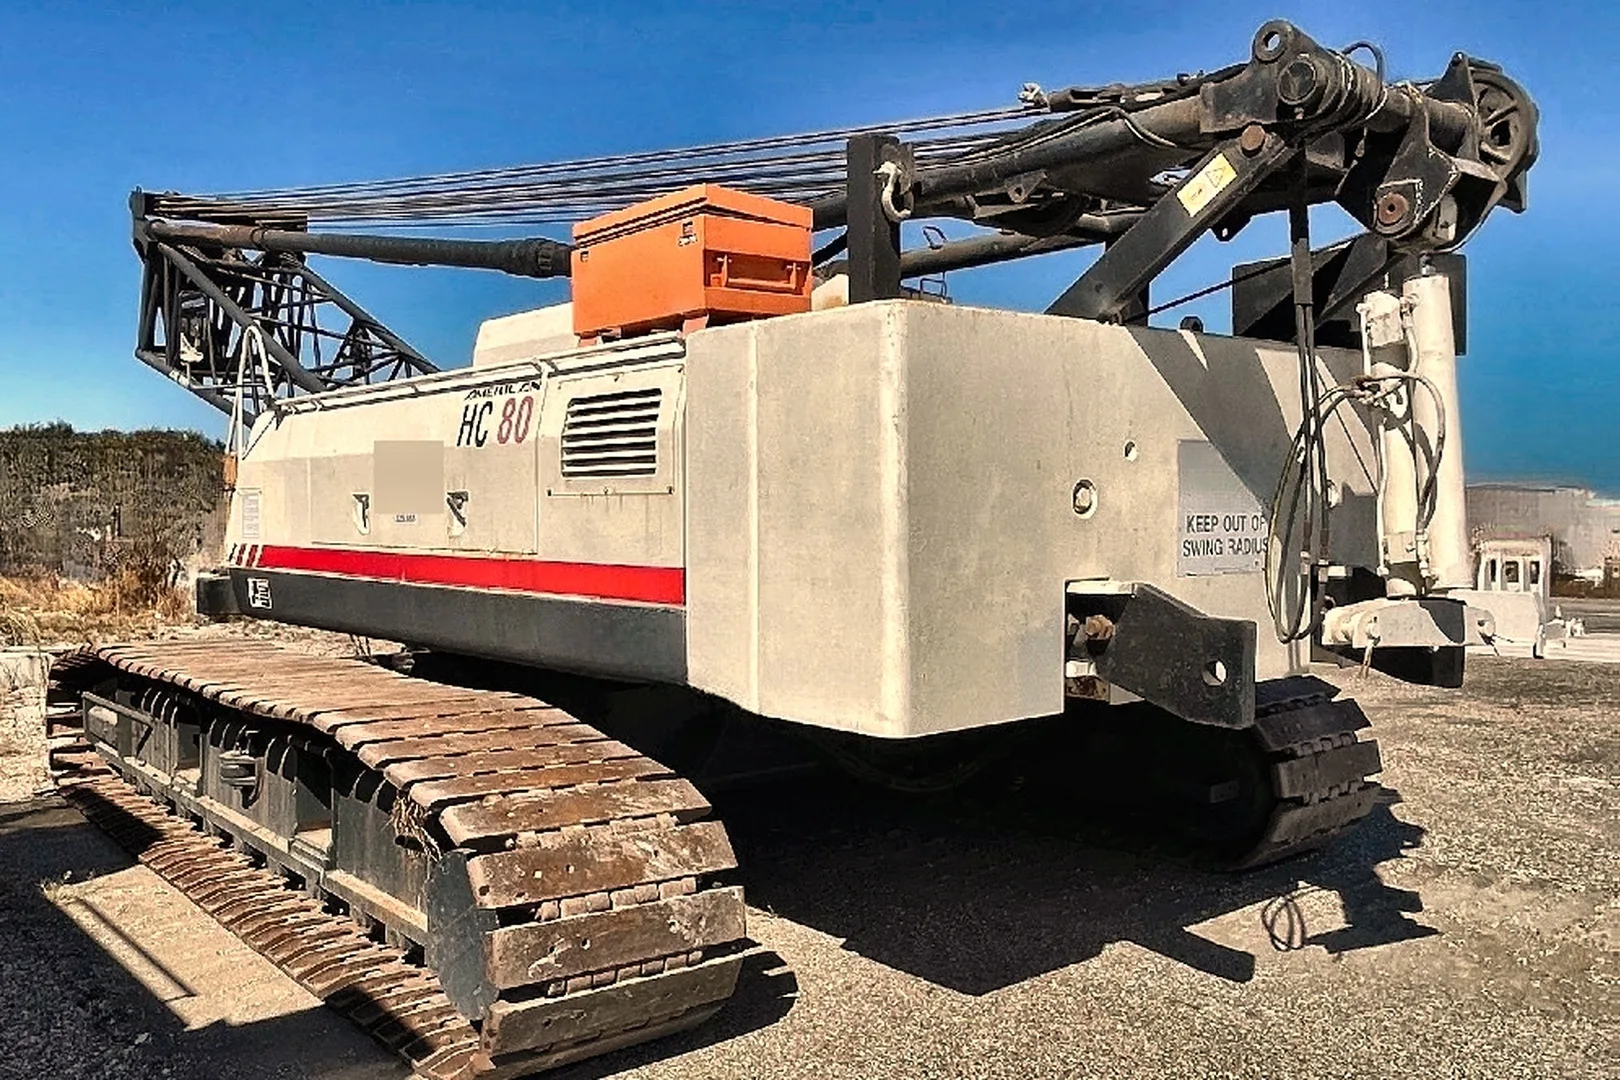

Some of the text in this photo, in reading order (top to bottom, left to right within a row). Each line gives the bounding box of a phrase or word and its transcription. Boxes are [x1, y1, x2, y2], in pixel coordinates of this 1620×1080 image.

[456, 396, 534, 448] HC 80
[1186, 514, 1219, 533] KEEP
[1223, 514, 1247, 532] OUT
[1182, 537, 1269, 557] SWING RADIUS
